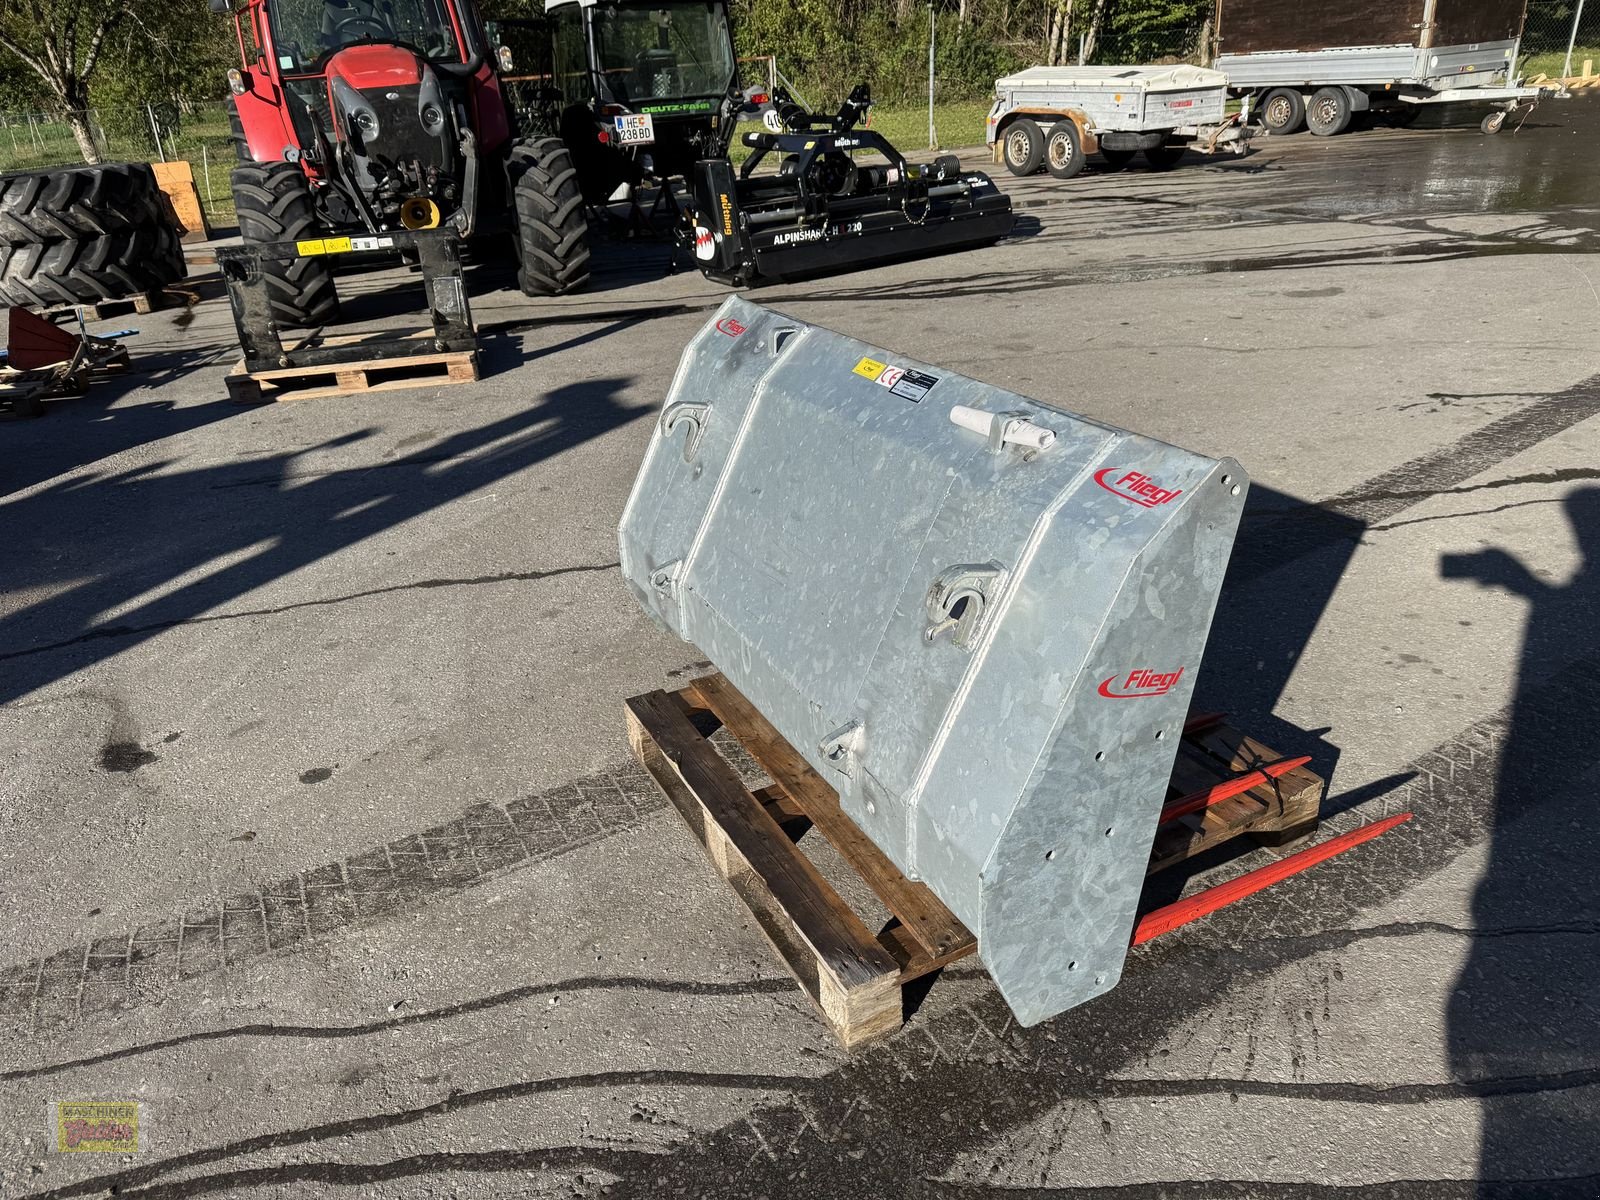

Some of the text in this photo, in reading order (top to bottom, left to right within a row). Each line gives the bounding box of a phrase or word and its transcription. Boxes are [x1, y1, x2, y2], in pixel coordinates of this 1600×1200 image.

[626, 117, 639, 128] HE
[621, 127, 651, 141] 238 BD
[719, 193, 733, 236] Müthing
[847, 221, 863, 233] 220
[724, 319, 749, 336] Fliegl
[1115, 470, 1183, 507] Fliegl
[1123, 667, 1185, 691] Fliegl
